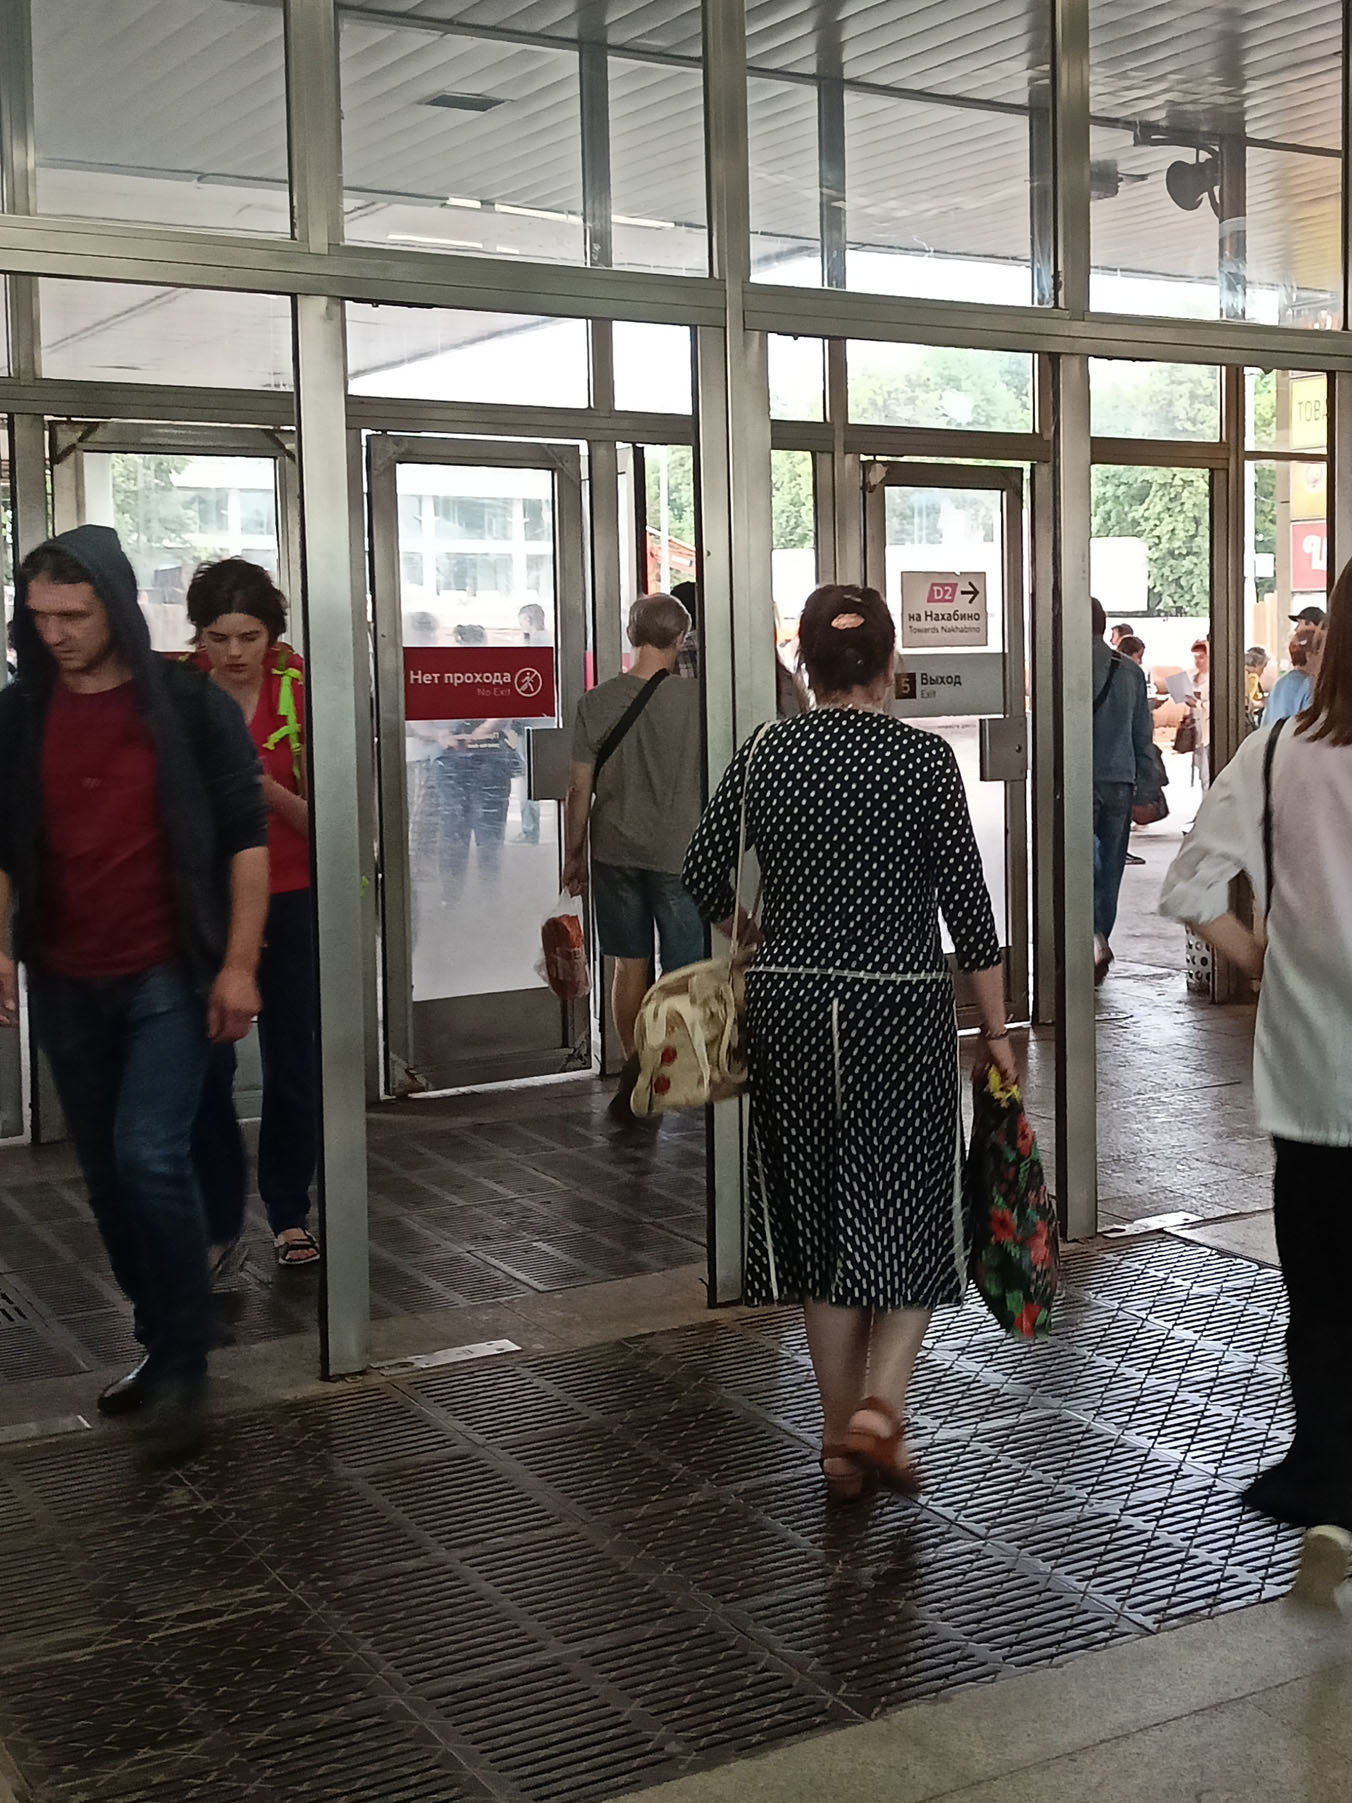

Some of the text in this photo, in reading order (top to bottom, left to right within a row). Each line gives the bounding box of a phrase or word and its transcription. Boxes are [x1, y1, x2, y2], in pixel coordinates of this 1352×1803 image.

[932, 586, 953, 600] D2
[908, 609, 981, 622] на Нахабино
[908, 625, 981, 634] Towards Nakhabino
[409, 670, 512, 687] Нет прохода
[920, 672, 962, 687] Выход
[477, 687, 511, 697] No Exit
